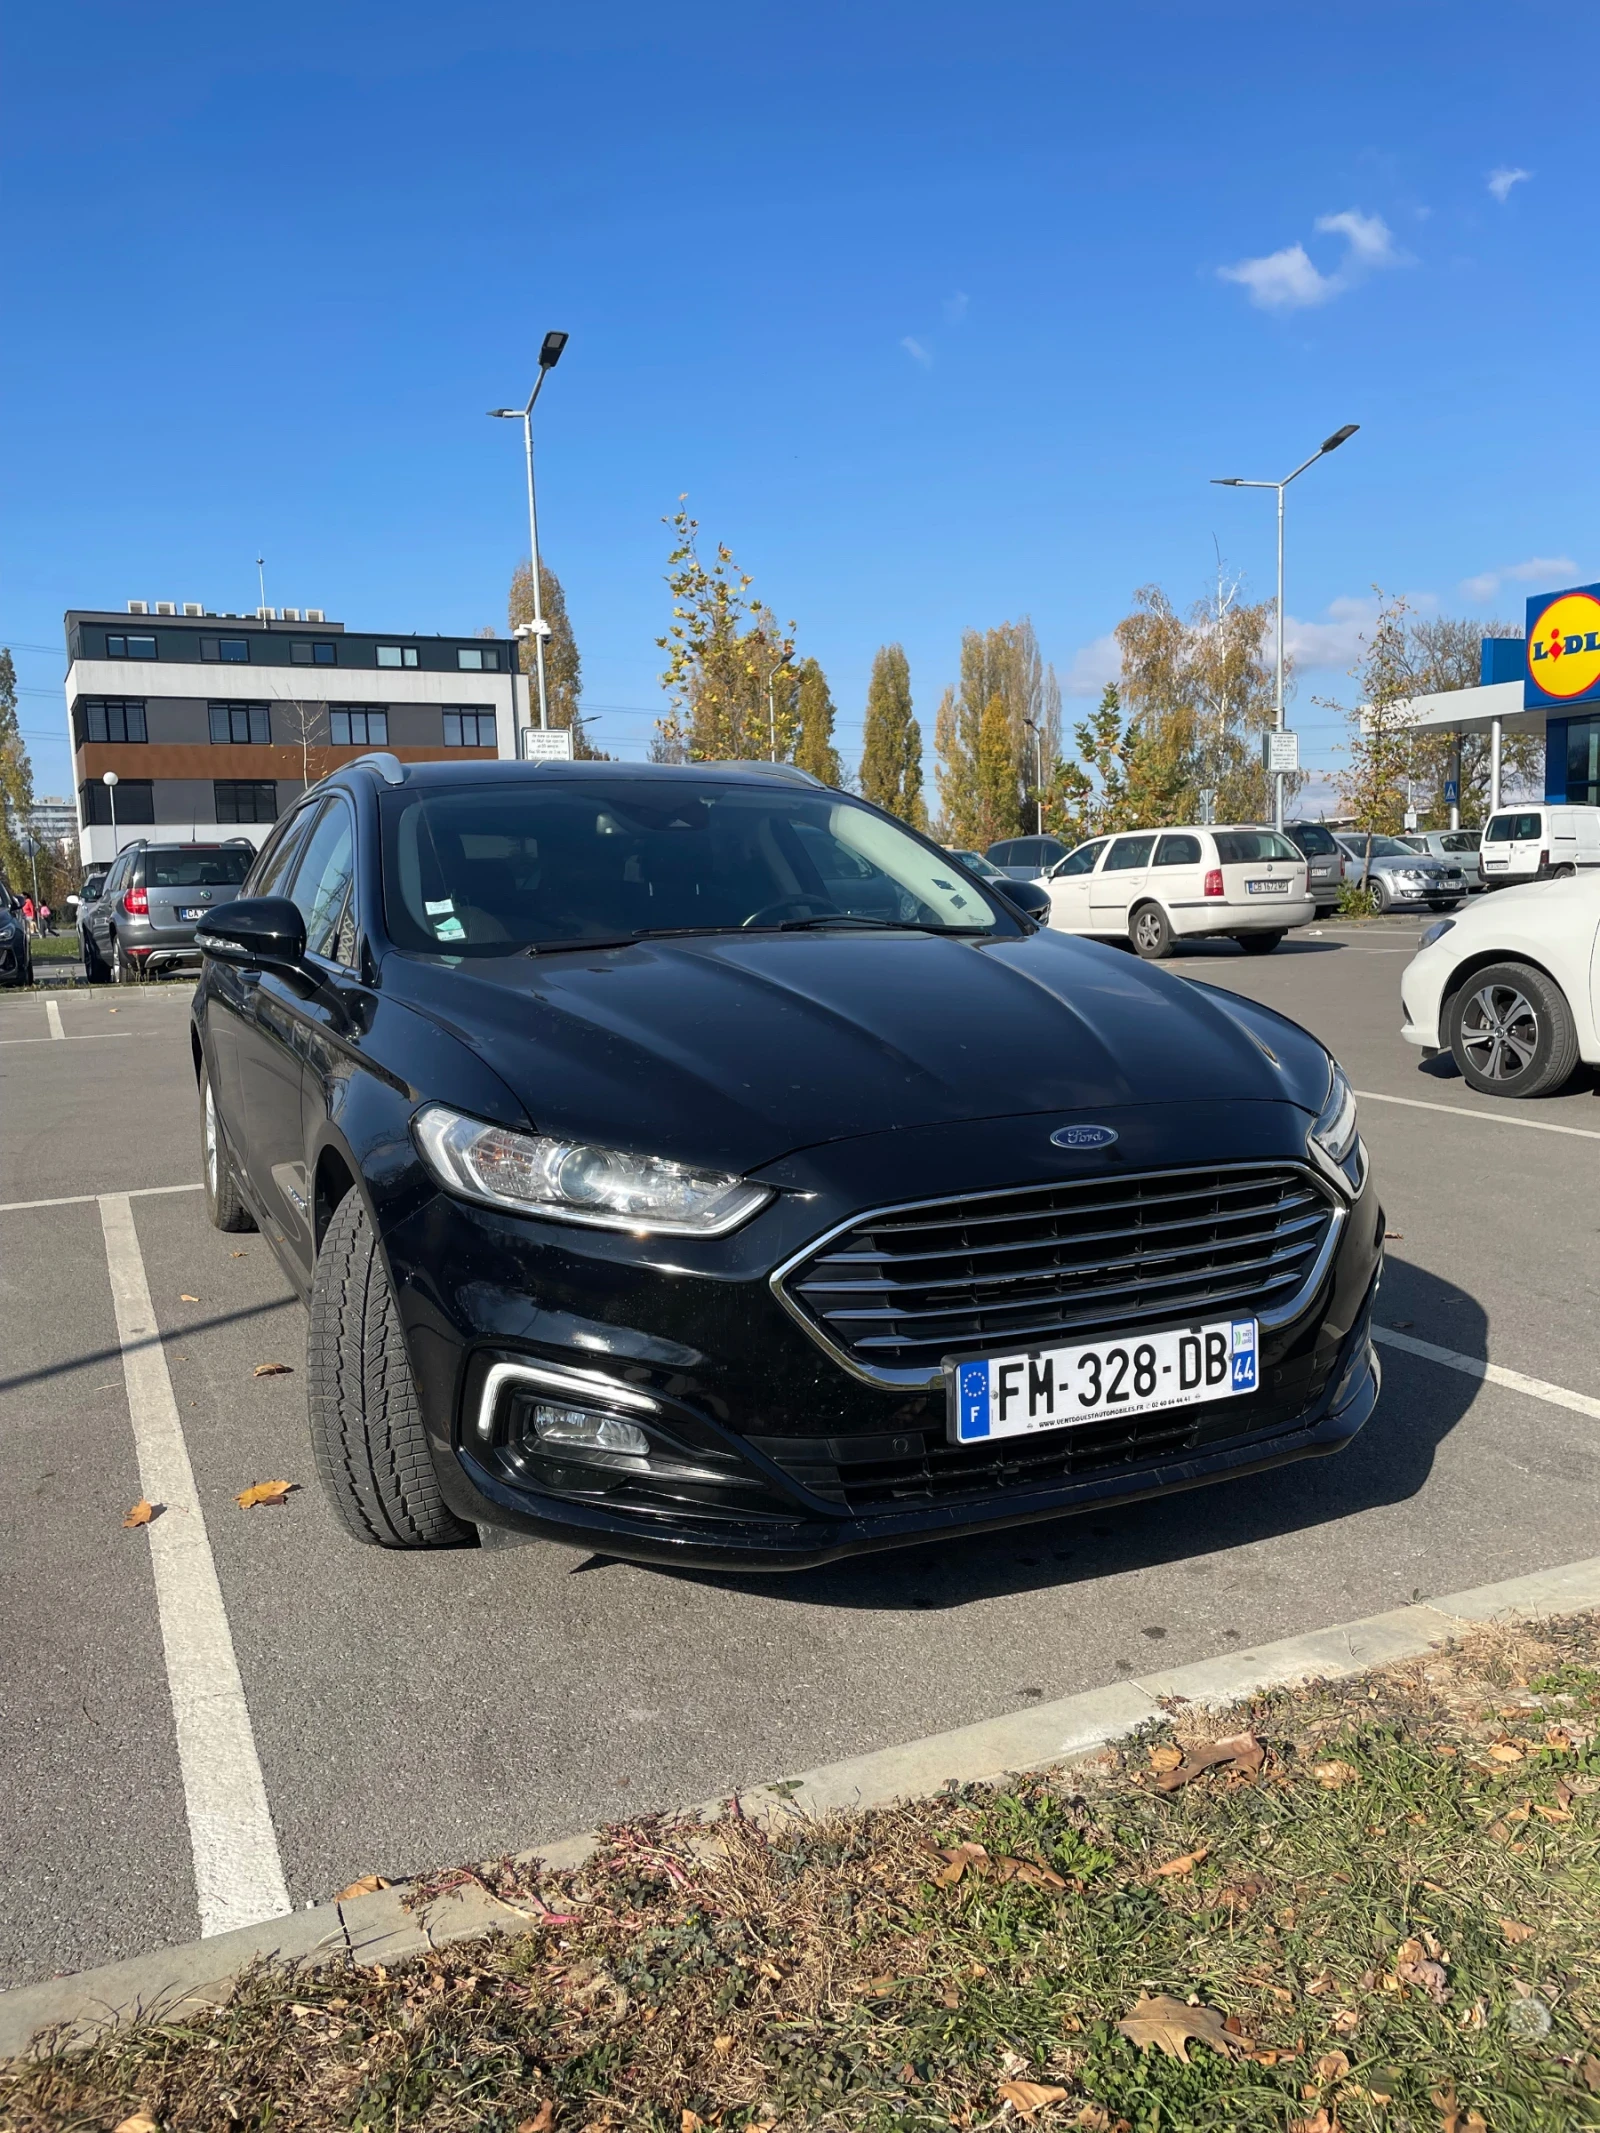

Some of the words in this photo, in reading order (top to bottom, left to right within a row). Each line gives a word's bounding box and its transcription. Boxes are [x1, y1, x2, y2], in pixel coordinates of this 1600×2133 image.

[188, 909, 199, 918] CA
[1067, 1129, 1104, 1144] Ford
[999, 1332, 1227, 1421] FM-328-DB
[1233, 1356, 1254, 1383] 44
[970, 1406, 980, 1422] F
